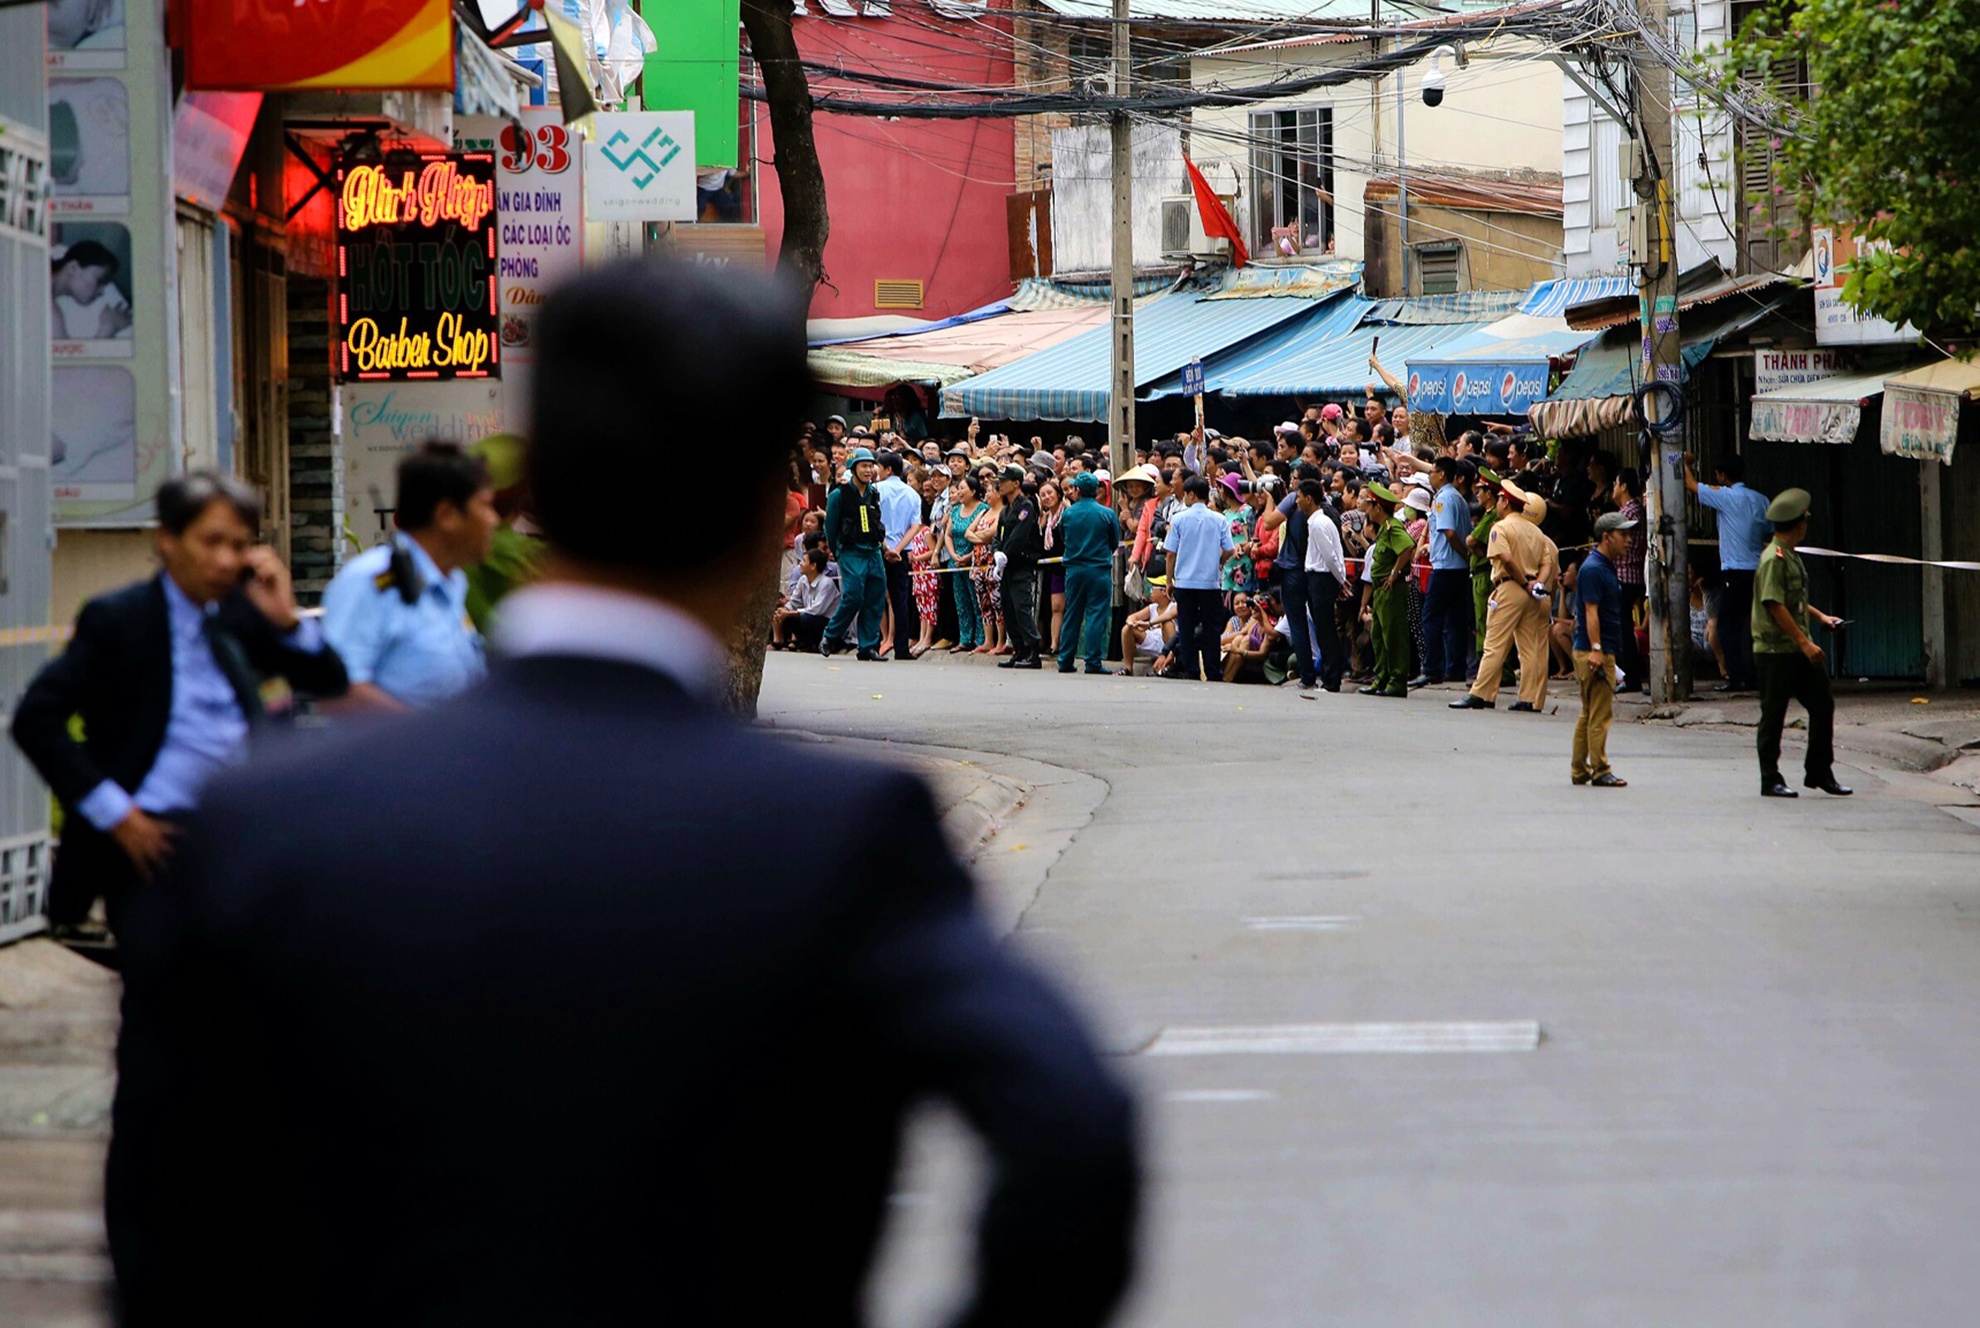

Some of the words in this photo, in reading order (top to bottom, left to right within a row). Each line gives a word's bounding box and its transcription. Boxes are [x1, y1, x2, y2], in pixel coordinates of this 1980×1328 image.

[500, 124, 571, 174] 93
[513, 191, 531, 211] GIA
[534, 186, 562, 212] ĐÌNH
[503, 219, 525, 245] CÁC
[528, 224, 553, 252] LOẠI
[556, 216, 571, 245] ỐC
[349, 226, 414, 312] HỚT
[417, 224, 486, 312] TÓC
[500, 251, 539, 278] PHÒNG
[348, 316, 431, 371] Barber
[432, 311, 489, 373] Shop
[1763, 352, 1808, 371] THÀNH
[1421, 377, 1447, 400] pepsi
[1466, 376, 1492, 400] pepsi
[1515, 376, 1543, 400] pepsi
[350, 388, 431, 438] Saigon
